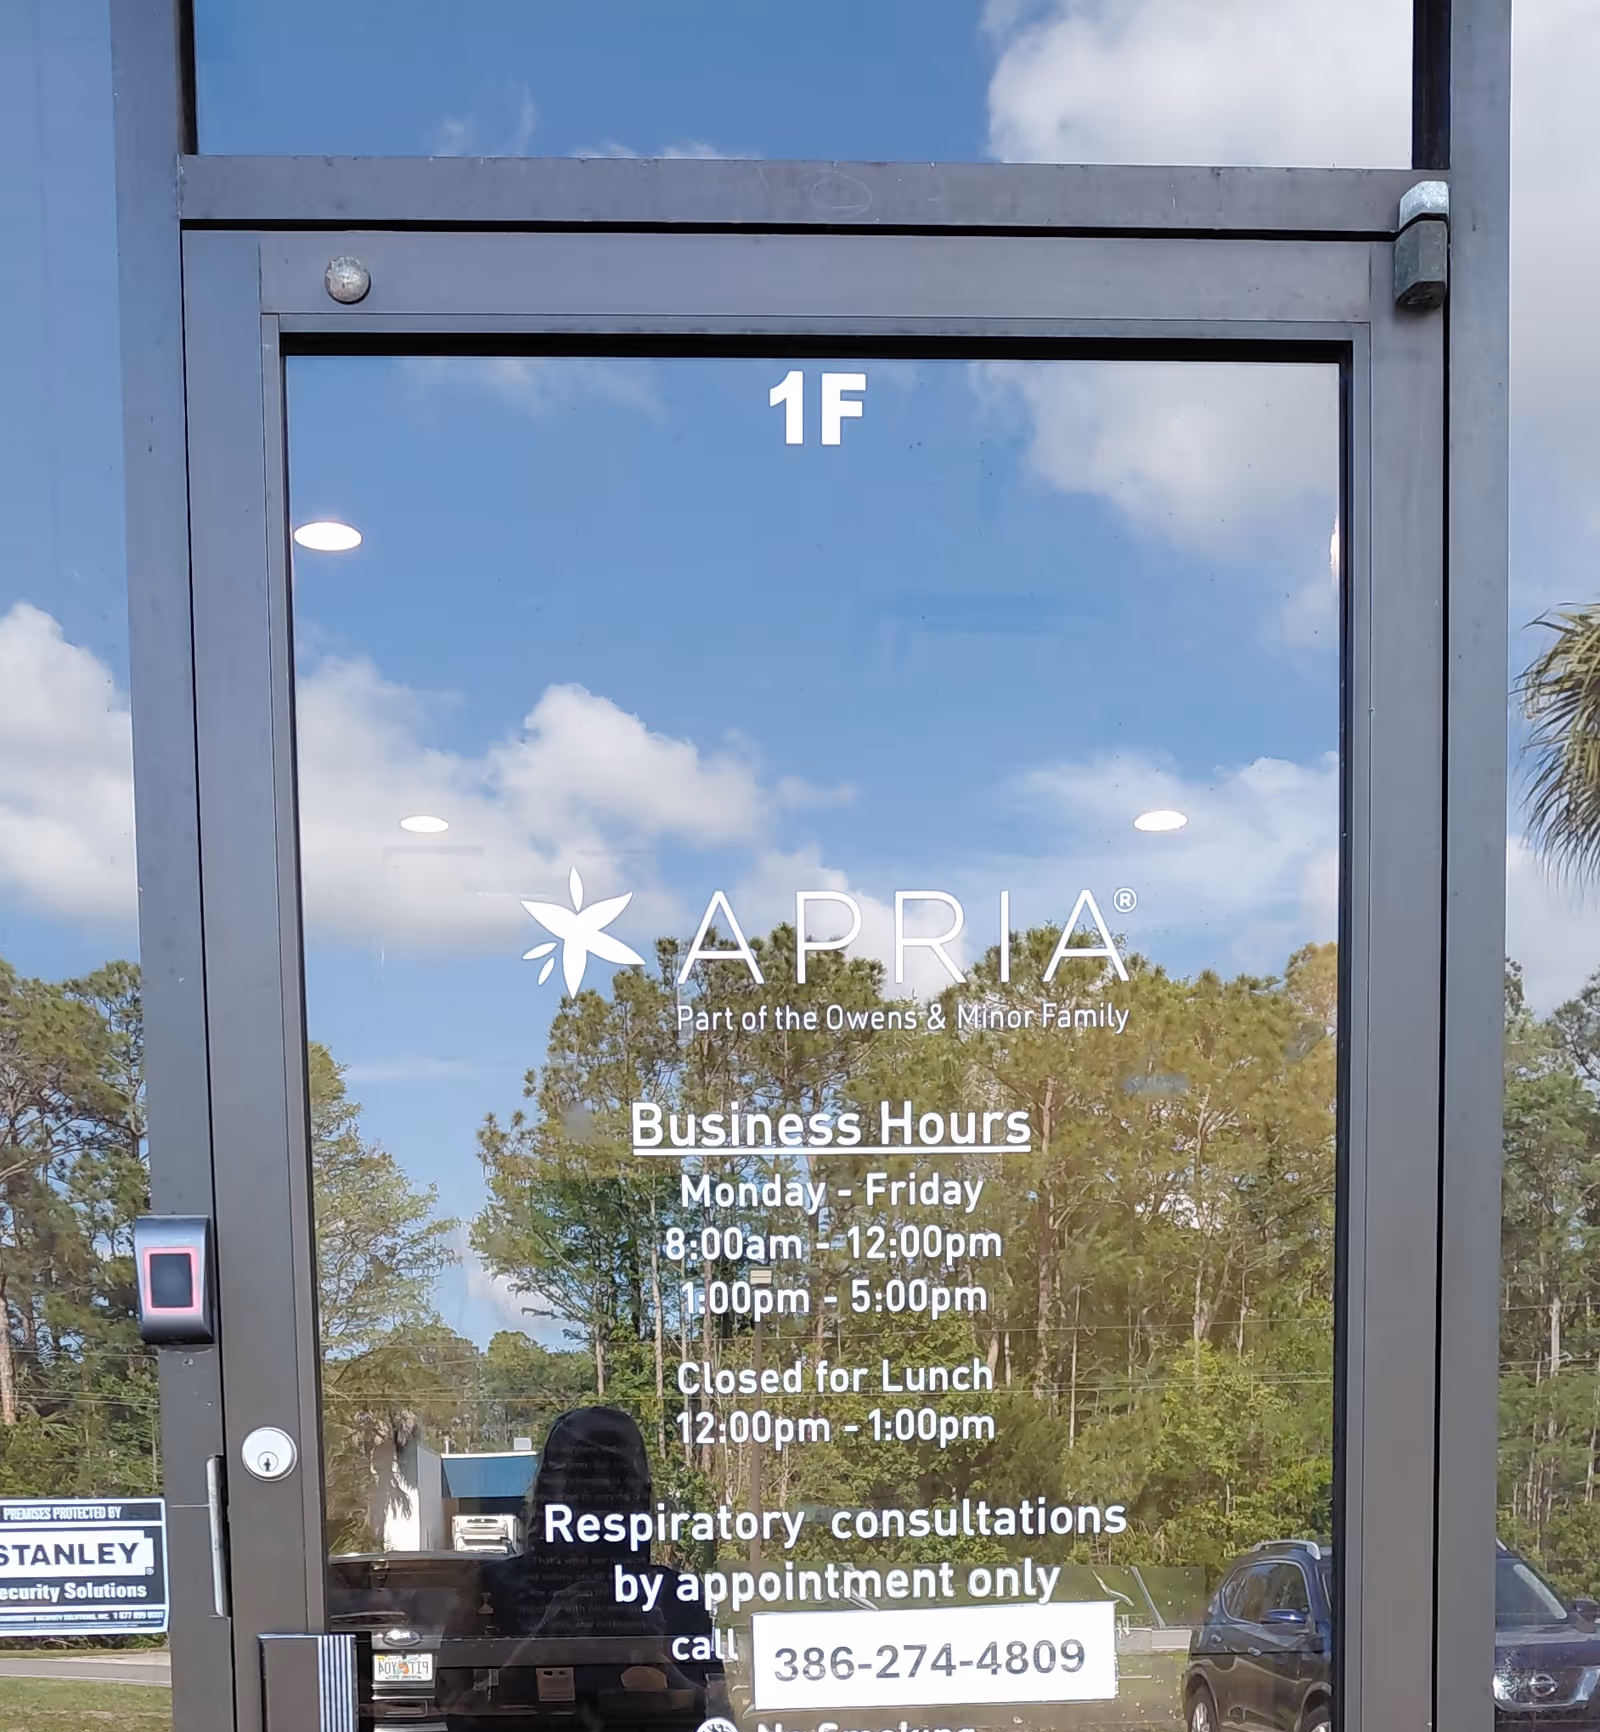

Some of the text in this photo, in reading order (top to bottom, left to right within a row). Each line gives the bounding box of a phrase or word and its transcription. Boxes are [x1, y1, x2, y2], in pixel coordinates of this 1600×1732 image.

[769, 369, 867, 445] 1F
[677, 889, 1130, 985] APRIA
[677, 1002, 1130, 1034] Part of the Owens & Minor Family
[632, 1099, 1031, 1147] Business Hours
[681, 1174, 826, 1214] Monday
[866, 1172, 984, 1213] Friday
[666, 1226, 802, 1260] 8:00am
[848, 1225, 1002, 1265] 12:00pm
[682, 1281, 810, 1322] 1:00pm
[851, 1279, 987, 1320] 5:00pm
[677, 1358, 993, 1396] Closed for Lunch
[676, 1411, 830, 1450] 12:00pm
[869, 1408, 995, 1448] 1:00pm
[3, 1506, 122, 1520] PREMISES PROTECTED BY
[545, 1497, 1126, 1549] Respiratory consultations
[0, 1583, 147, 1603] ecurity Solutions
[614, 1558, 1061, 1617] by appointment only
[672, 1627, 737, 1661] call
[774, 1639, 1085, 1682] 386-274-4809
